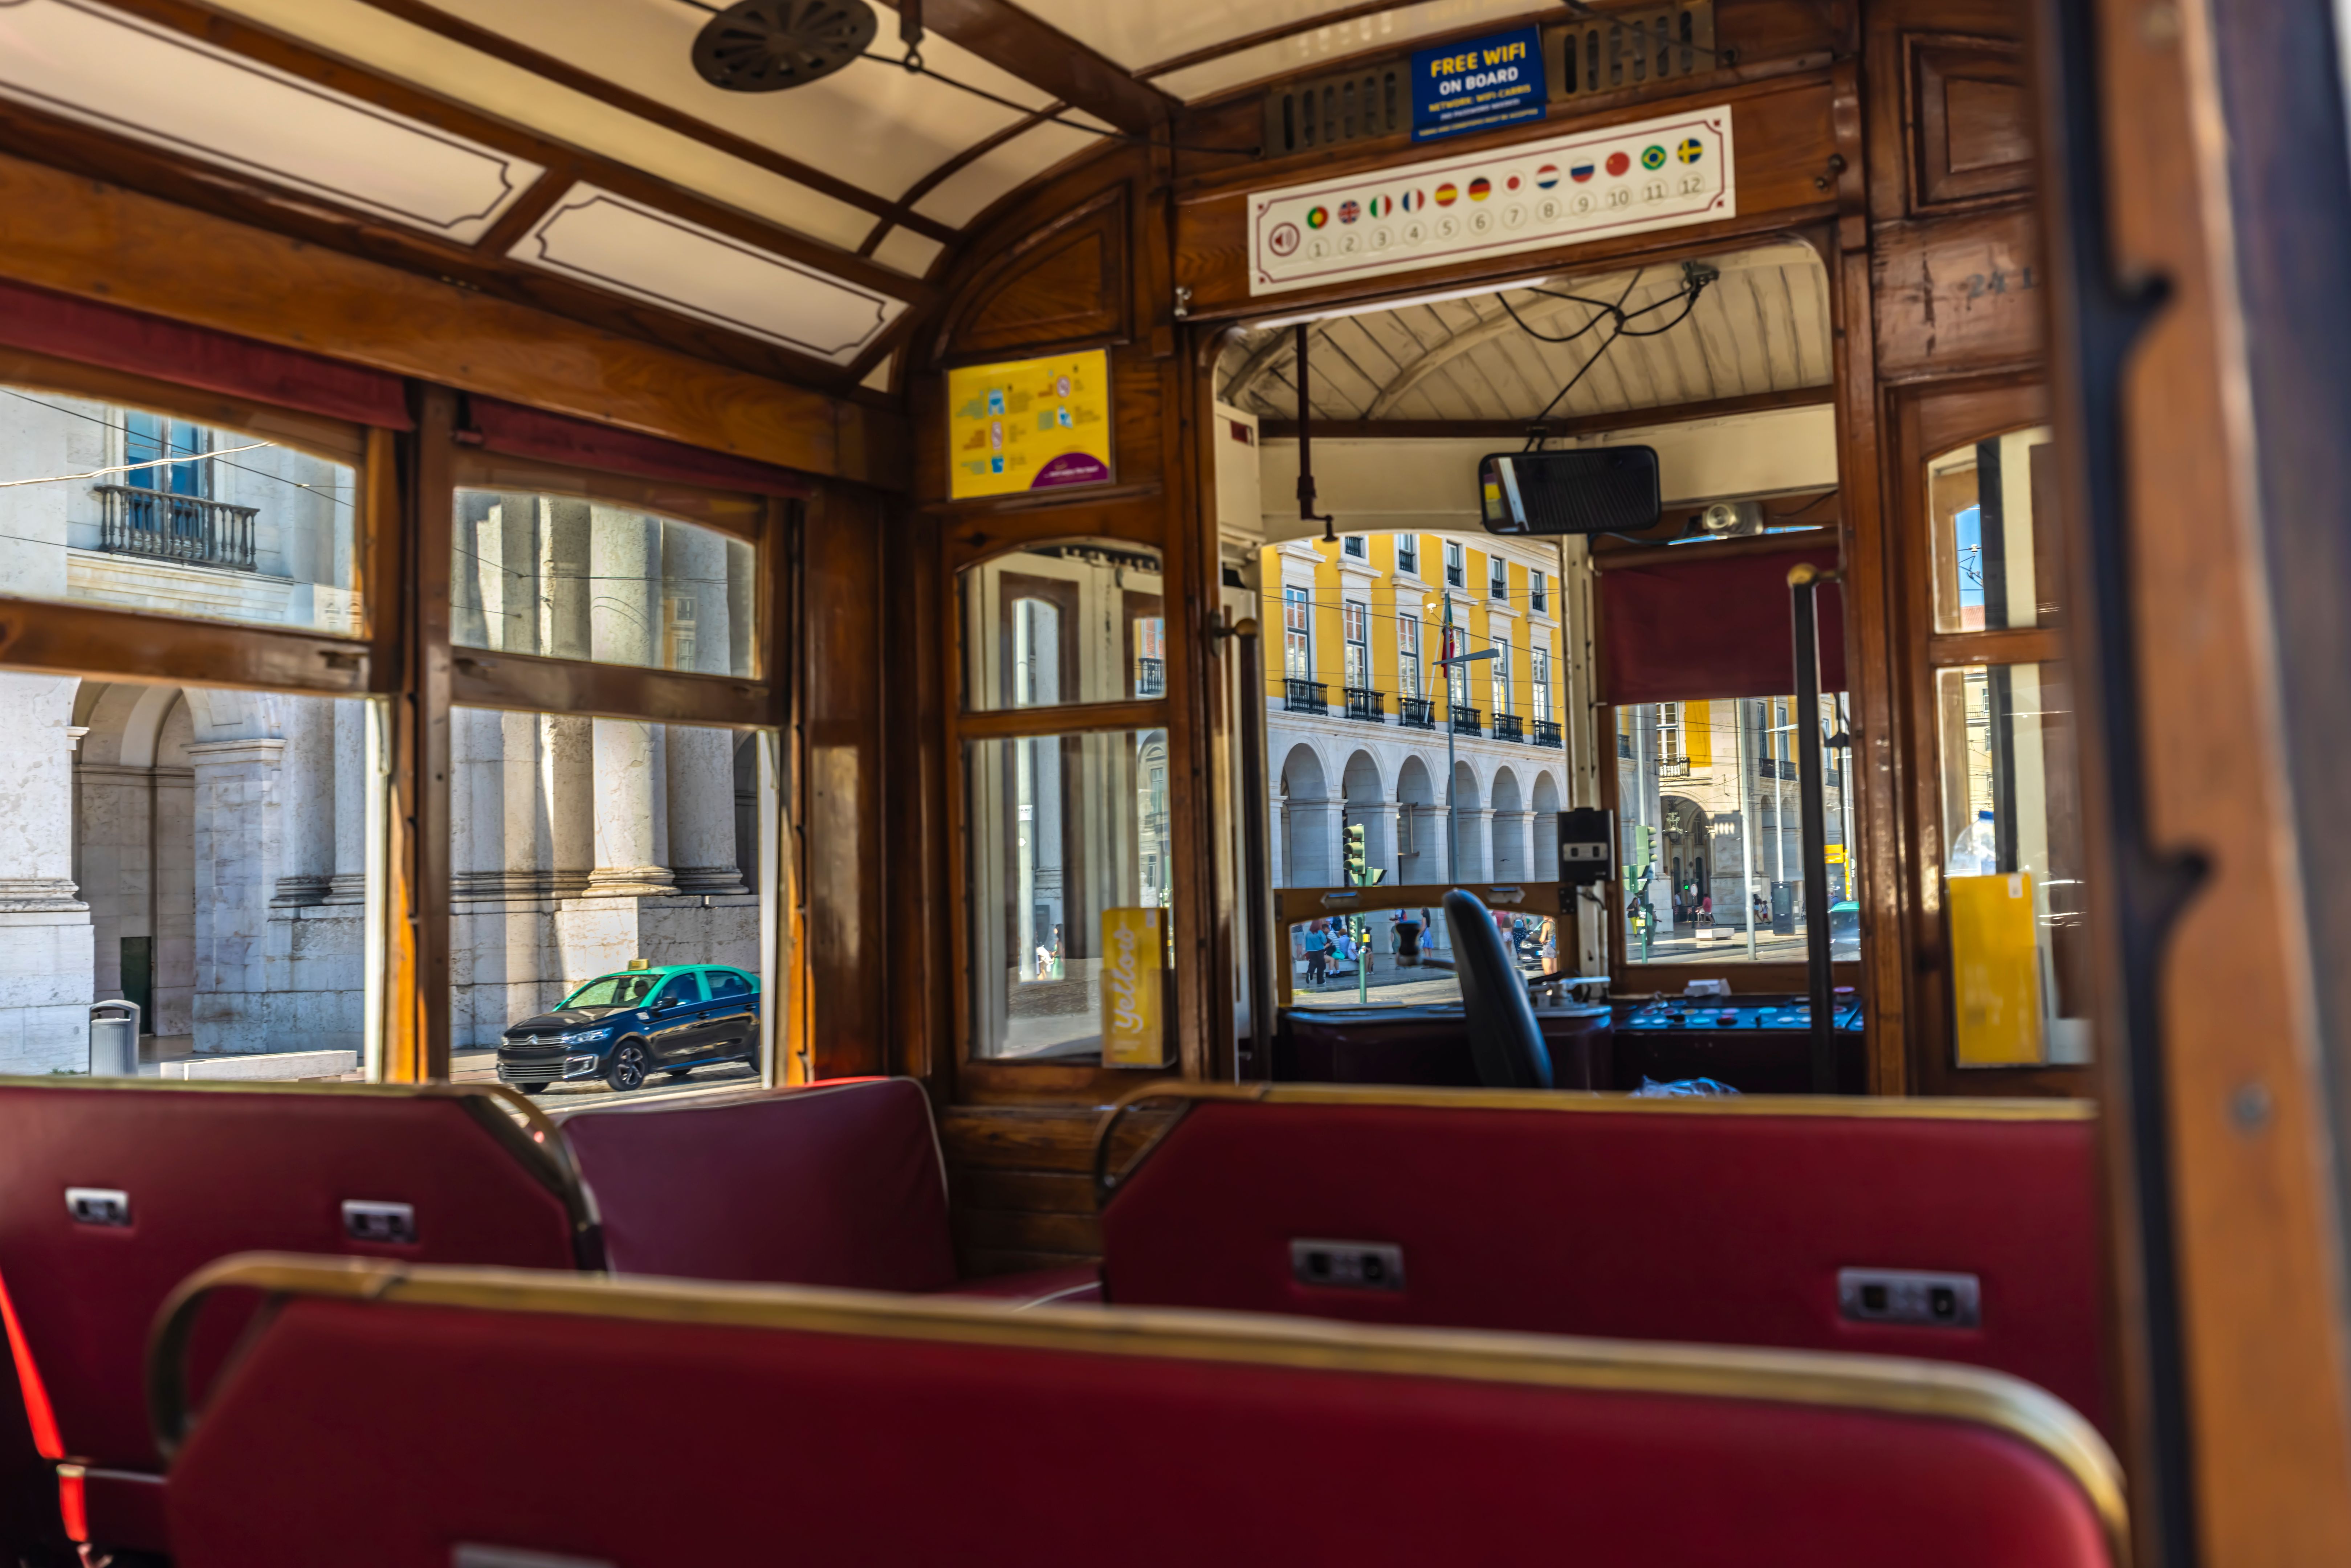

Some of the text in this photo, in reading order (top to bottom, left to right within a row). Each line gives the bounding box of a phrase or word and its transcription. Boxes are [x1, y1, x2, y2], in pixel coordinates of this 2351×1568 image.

[1431, 41, 1525, 78] FREE WIFI
[1439, 66, 1518, 95] ON BOARD
[1315, 177, 1701, 257] 1 2 3 4 5 6 7 8 9 10 11 12
